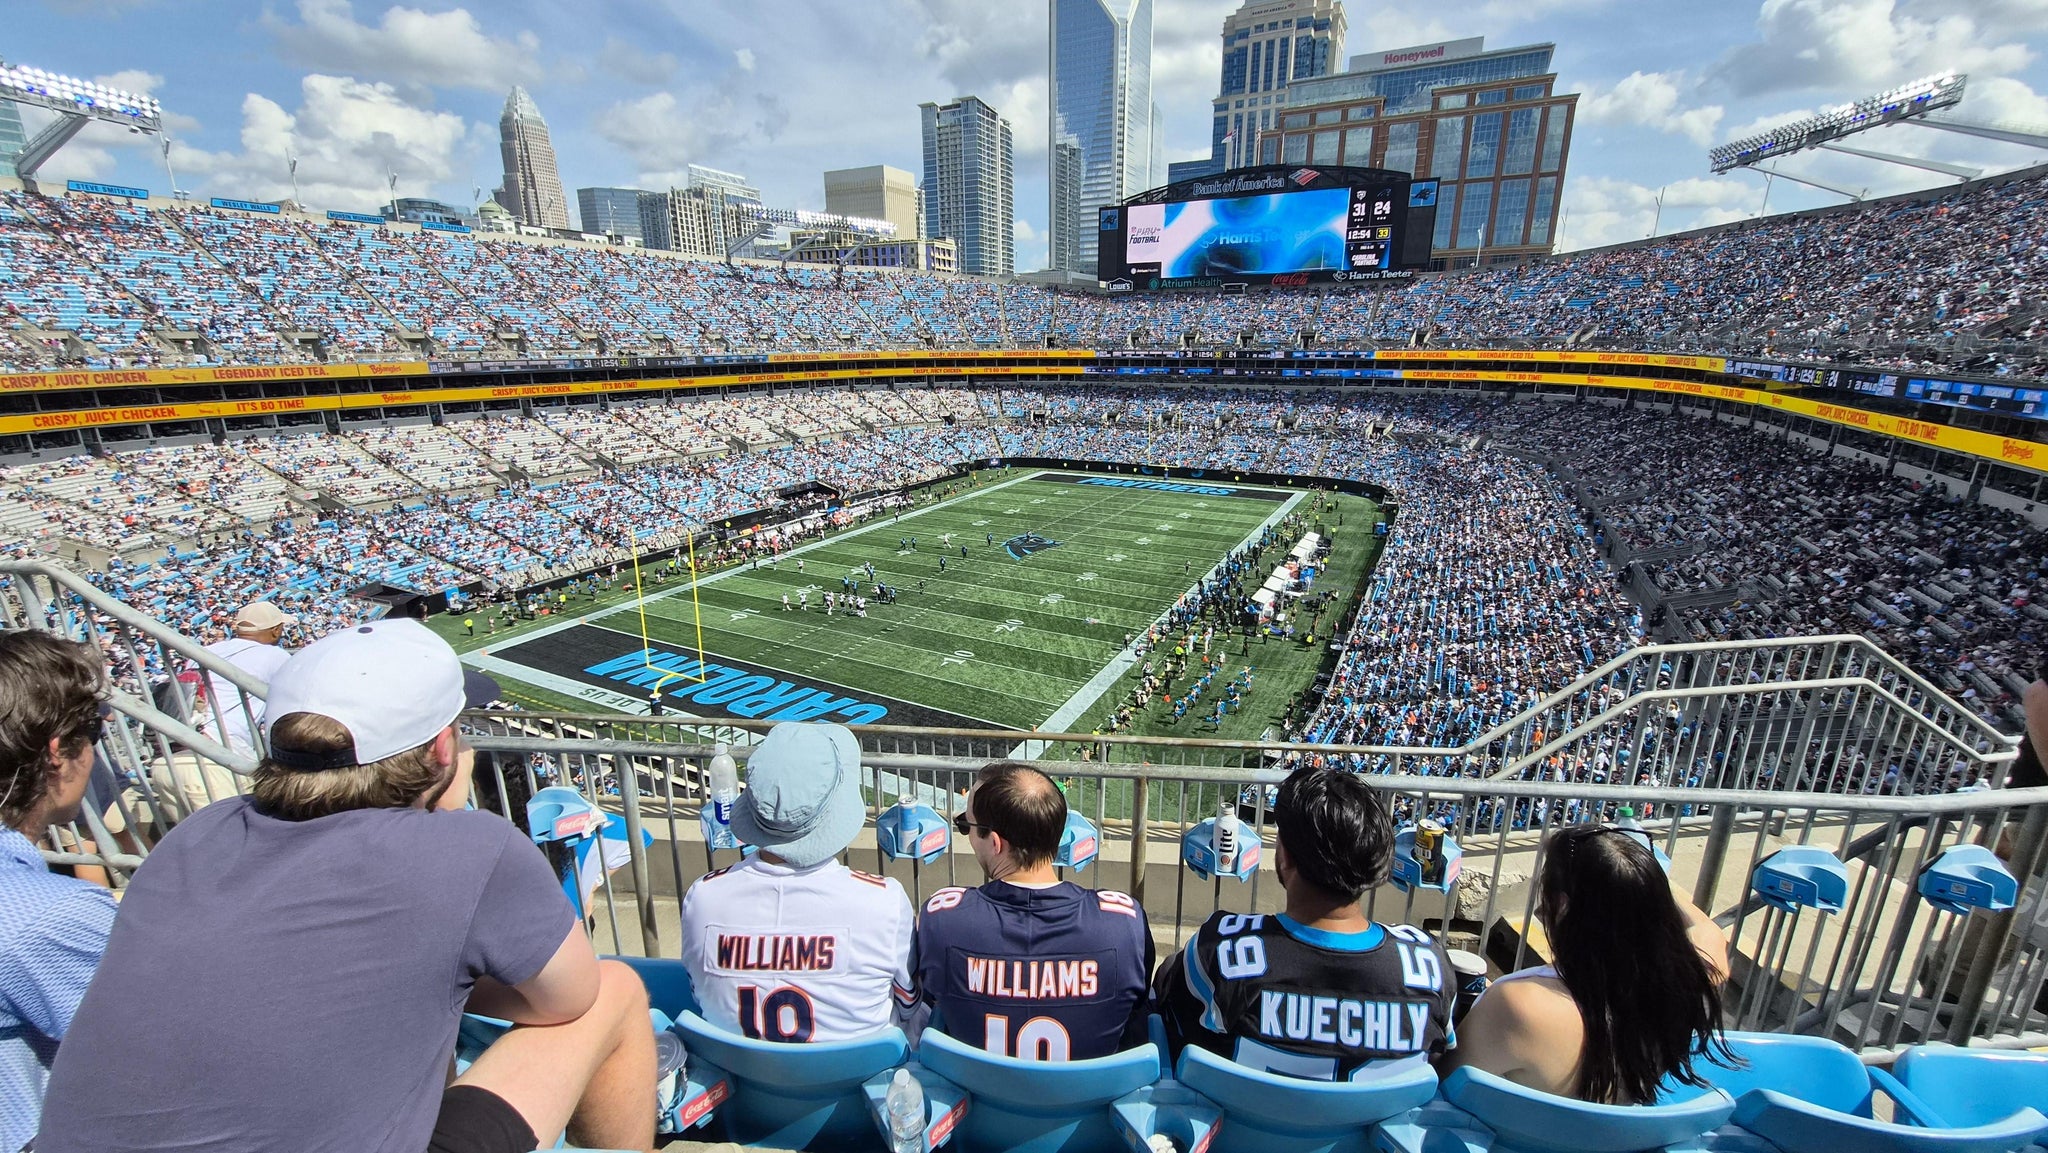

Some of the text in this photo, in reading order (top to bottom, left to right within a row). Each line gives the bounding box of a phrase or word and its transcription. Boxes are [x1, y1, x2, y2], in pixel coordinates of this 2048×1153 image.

[1384, 46, 1444, 64] Honeywell
[76, 183, 99, 192] STEVE
[102, 187, 126, 195] SMITH
[1193, 176, 1284, 195] Bank of America
[221, 201, 271, 211] WESLEY WALLS
[1352, 201, 1390, 216] 31 24
[1129, 235, 1160, 244] FOOTBALL
[1219, 230, 1262, 244] Harris
[1348, 229, 1389, 240] 12:54 33
[1349, 270, 1412, 280] Harris Teeter
[1161, 278, 1222, 288] Atrium Health
[584, 360, 593, 368] 31
[600, 359, 618, 368] 12:54
[637, 358, 647, 367] 24
[213, 366, 329, 379] LEGENDARY ICED TEA.
[0, 372, 152, 389] CRISPY, JUICY CHICKEN.
[492, 386, 572, 397] CRISPY, JUICY CHICKEN.
[236, 399, 305, 412] IT'S BO TIME!
[33, 407, 180, 428] CRISPY, JUICY CHICKEN.
[1077, 477, 1237, 496] PANTHERS
[583, 647, 888, 724] CAROLINA
[579, 688, 603, 700] US
[1096, 890, 1137, 919] 18
[716, 934, 836, 972] WILLIAMS
[1216, 913, 1269, 981] 59
[966, 956, 1099, 1000] WILLIAMS
[1260, 989, 1430, 1051] KUECHLY
[684, 1086, 724, 1120] Coca-Cola
